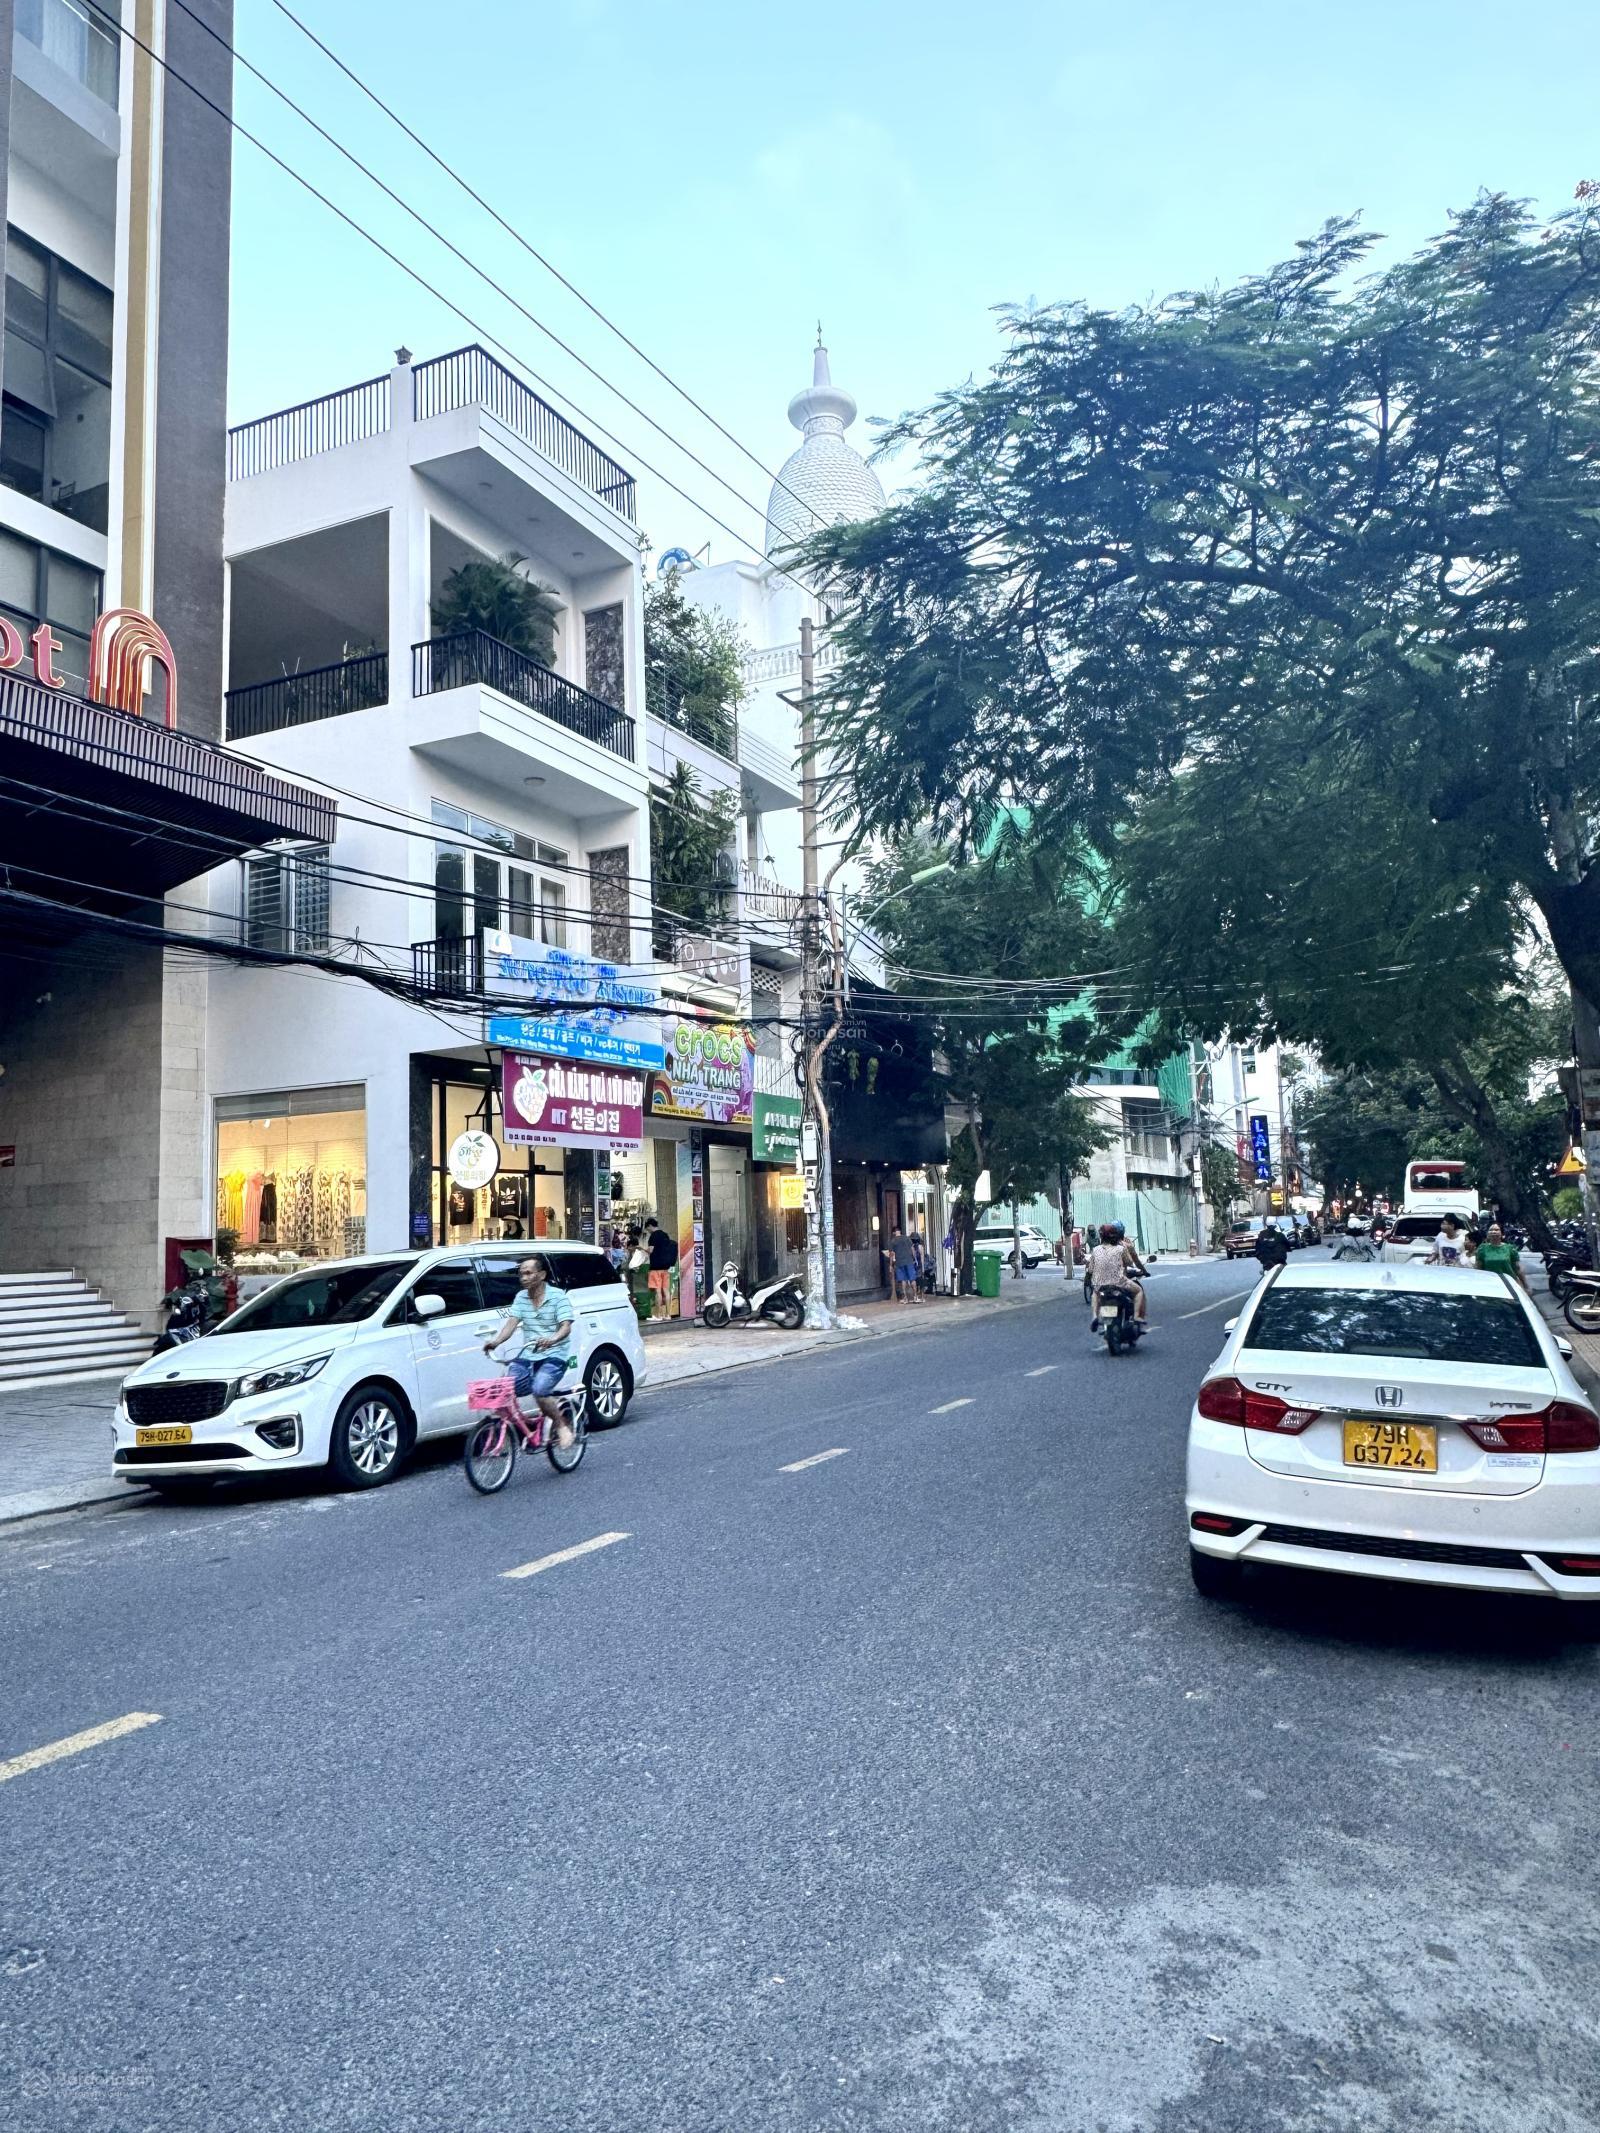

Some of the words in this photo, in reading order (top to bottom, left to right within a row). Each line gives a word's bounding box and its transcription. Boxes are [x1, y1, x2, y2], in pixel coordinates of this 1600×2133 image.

[675, 1024, 745, 1067] crocs
[673, 1057, 698, 1083] NHA
[703, 1065, 740, 1088] TRANG
[1255, 1382, 1293, 1392] CITY
[1368, 1423, 1409, 1445] 79H
[1354, 1444, 1427, 1468] 037.24
